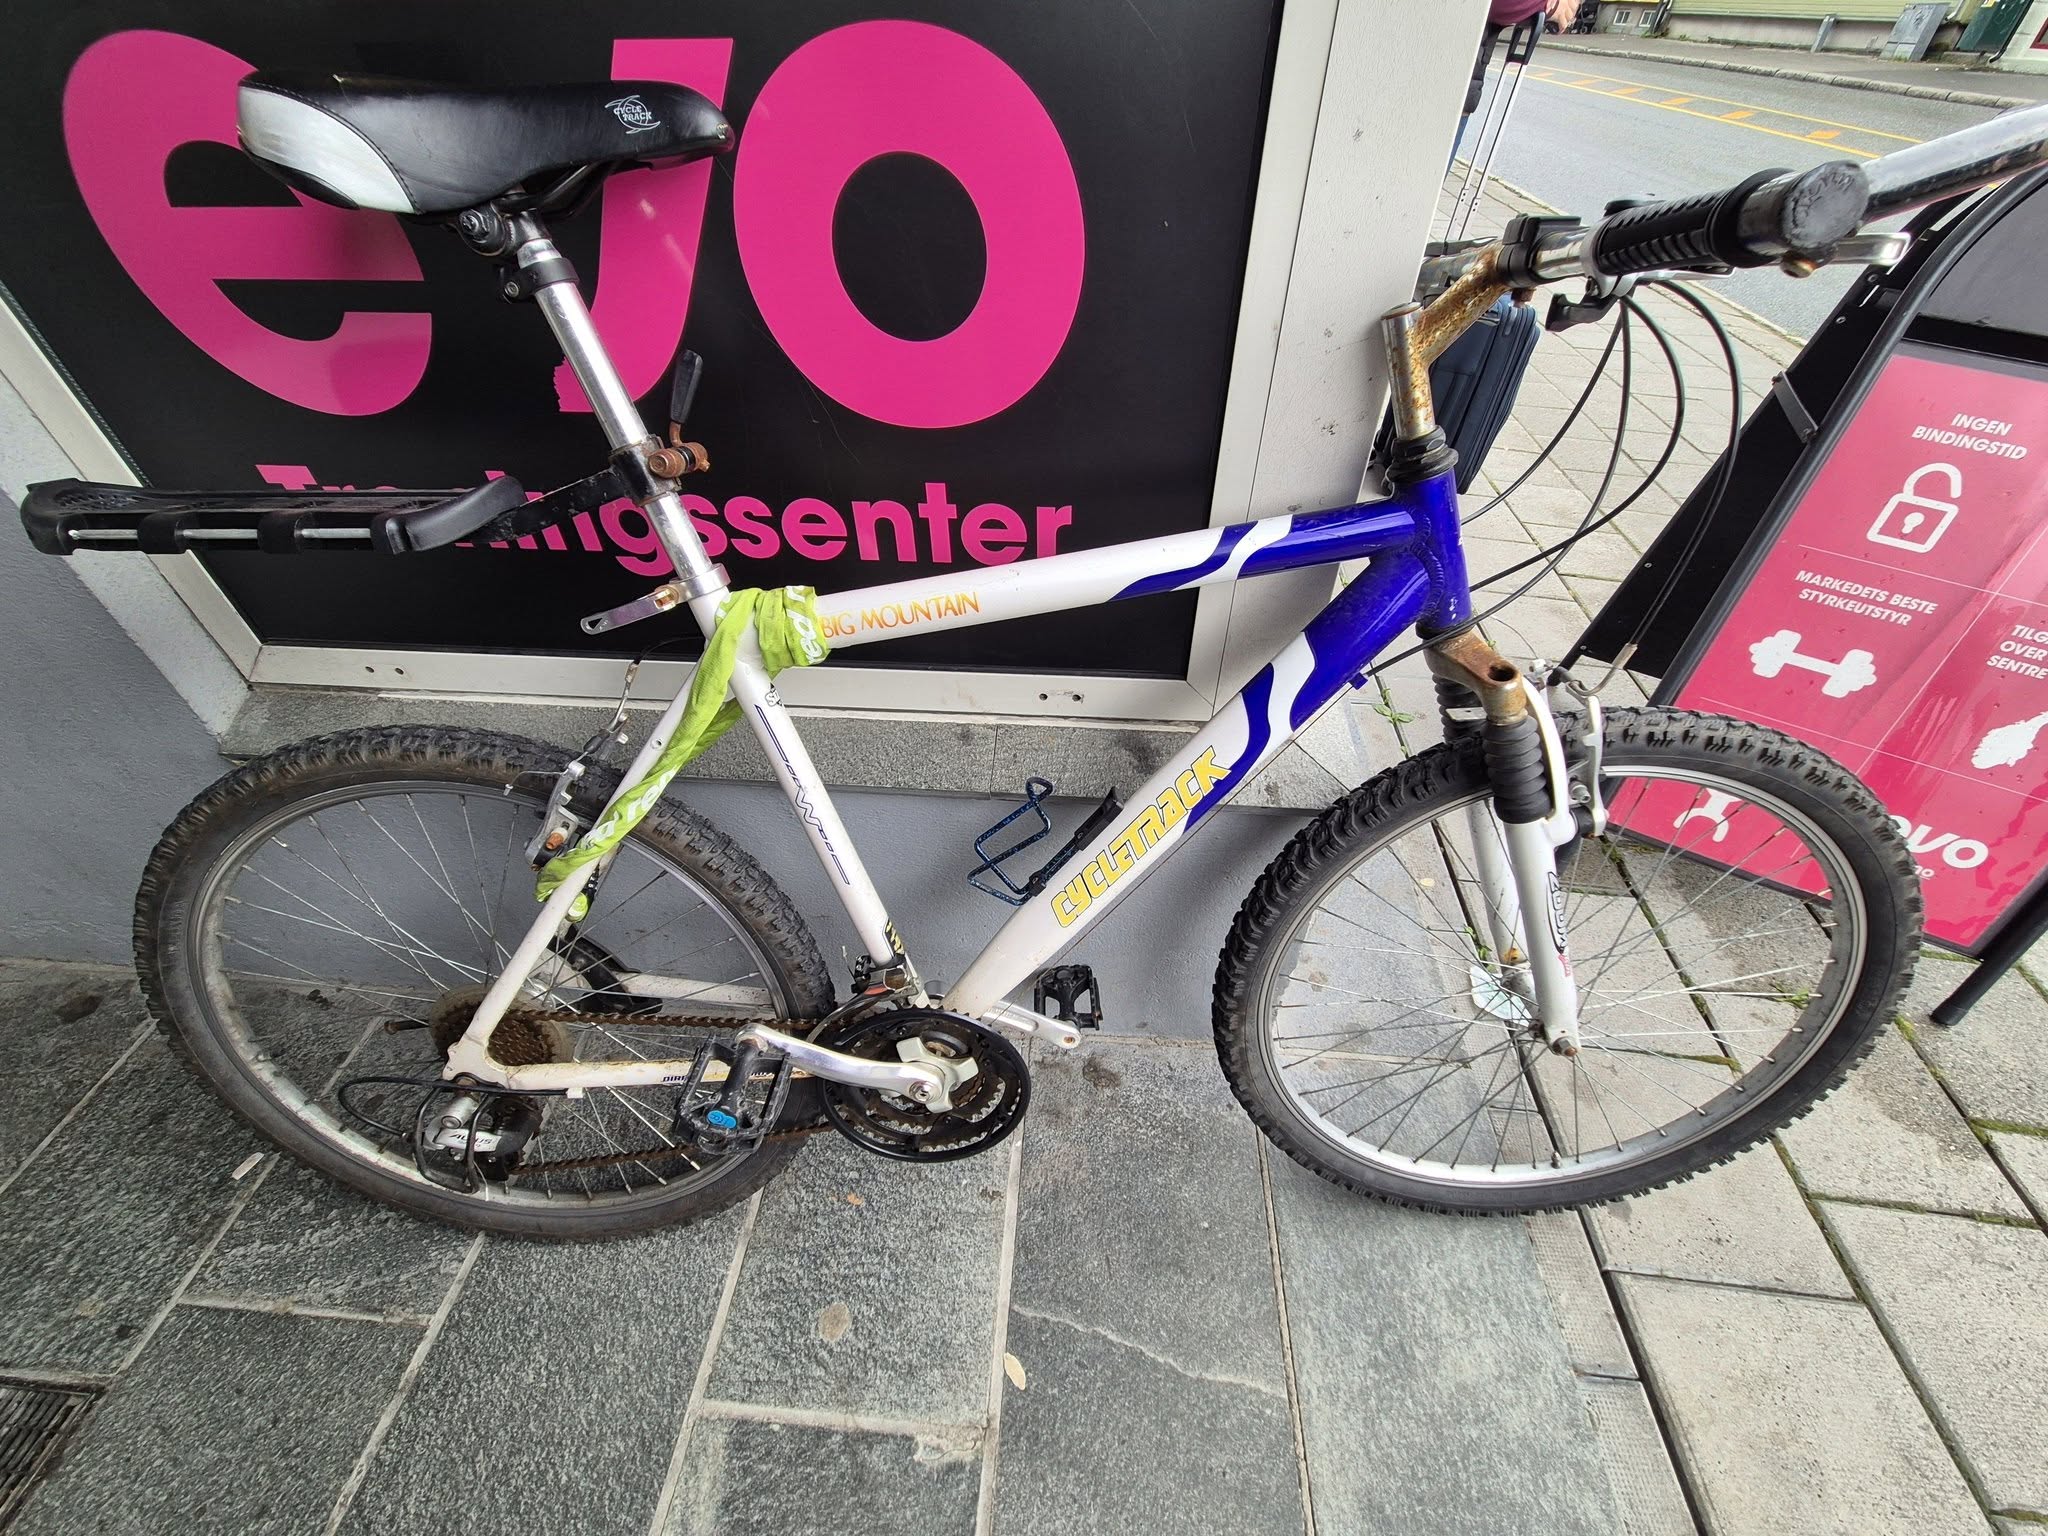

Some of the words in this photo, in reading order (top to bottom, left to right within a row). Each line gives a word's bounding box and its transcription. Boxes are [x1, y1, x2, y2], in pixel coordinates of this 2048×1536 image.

[613, 105, 642, 116] CYCLE
[622, 111, 653, 121] TRACK
[1951, 413, 2013, 436] INGEN
[1911, 425, 2028, 460] BINDINGSTID
[1795, 570, 1889, 602] MARKEDETS
[1888, 594, 1939, 615] BESTE
[1798, 588, 1913, 626] STYRKEUTSTYR
[819, 612, 856, 639] BIG
[860, 591, 981, 629] MOUNTAIN
[2011, 624, 2048, 645] TILG
[2000, 640, 2048, 661] OVER
[1051, 745, 1231, 928] CYCLETRACK
